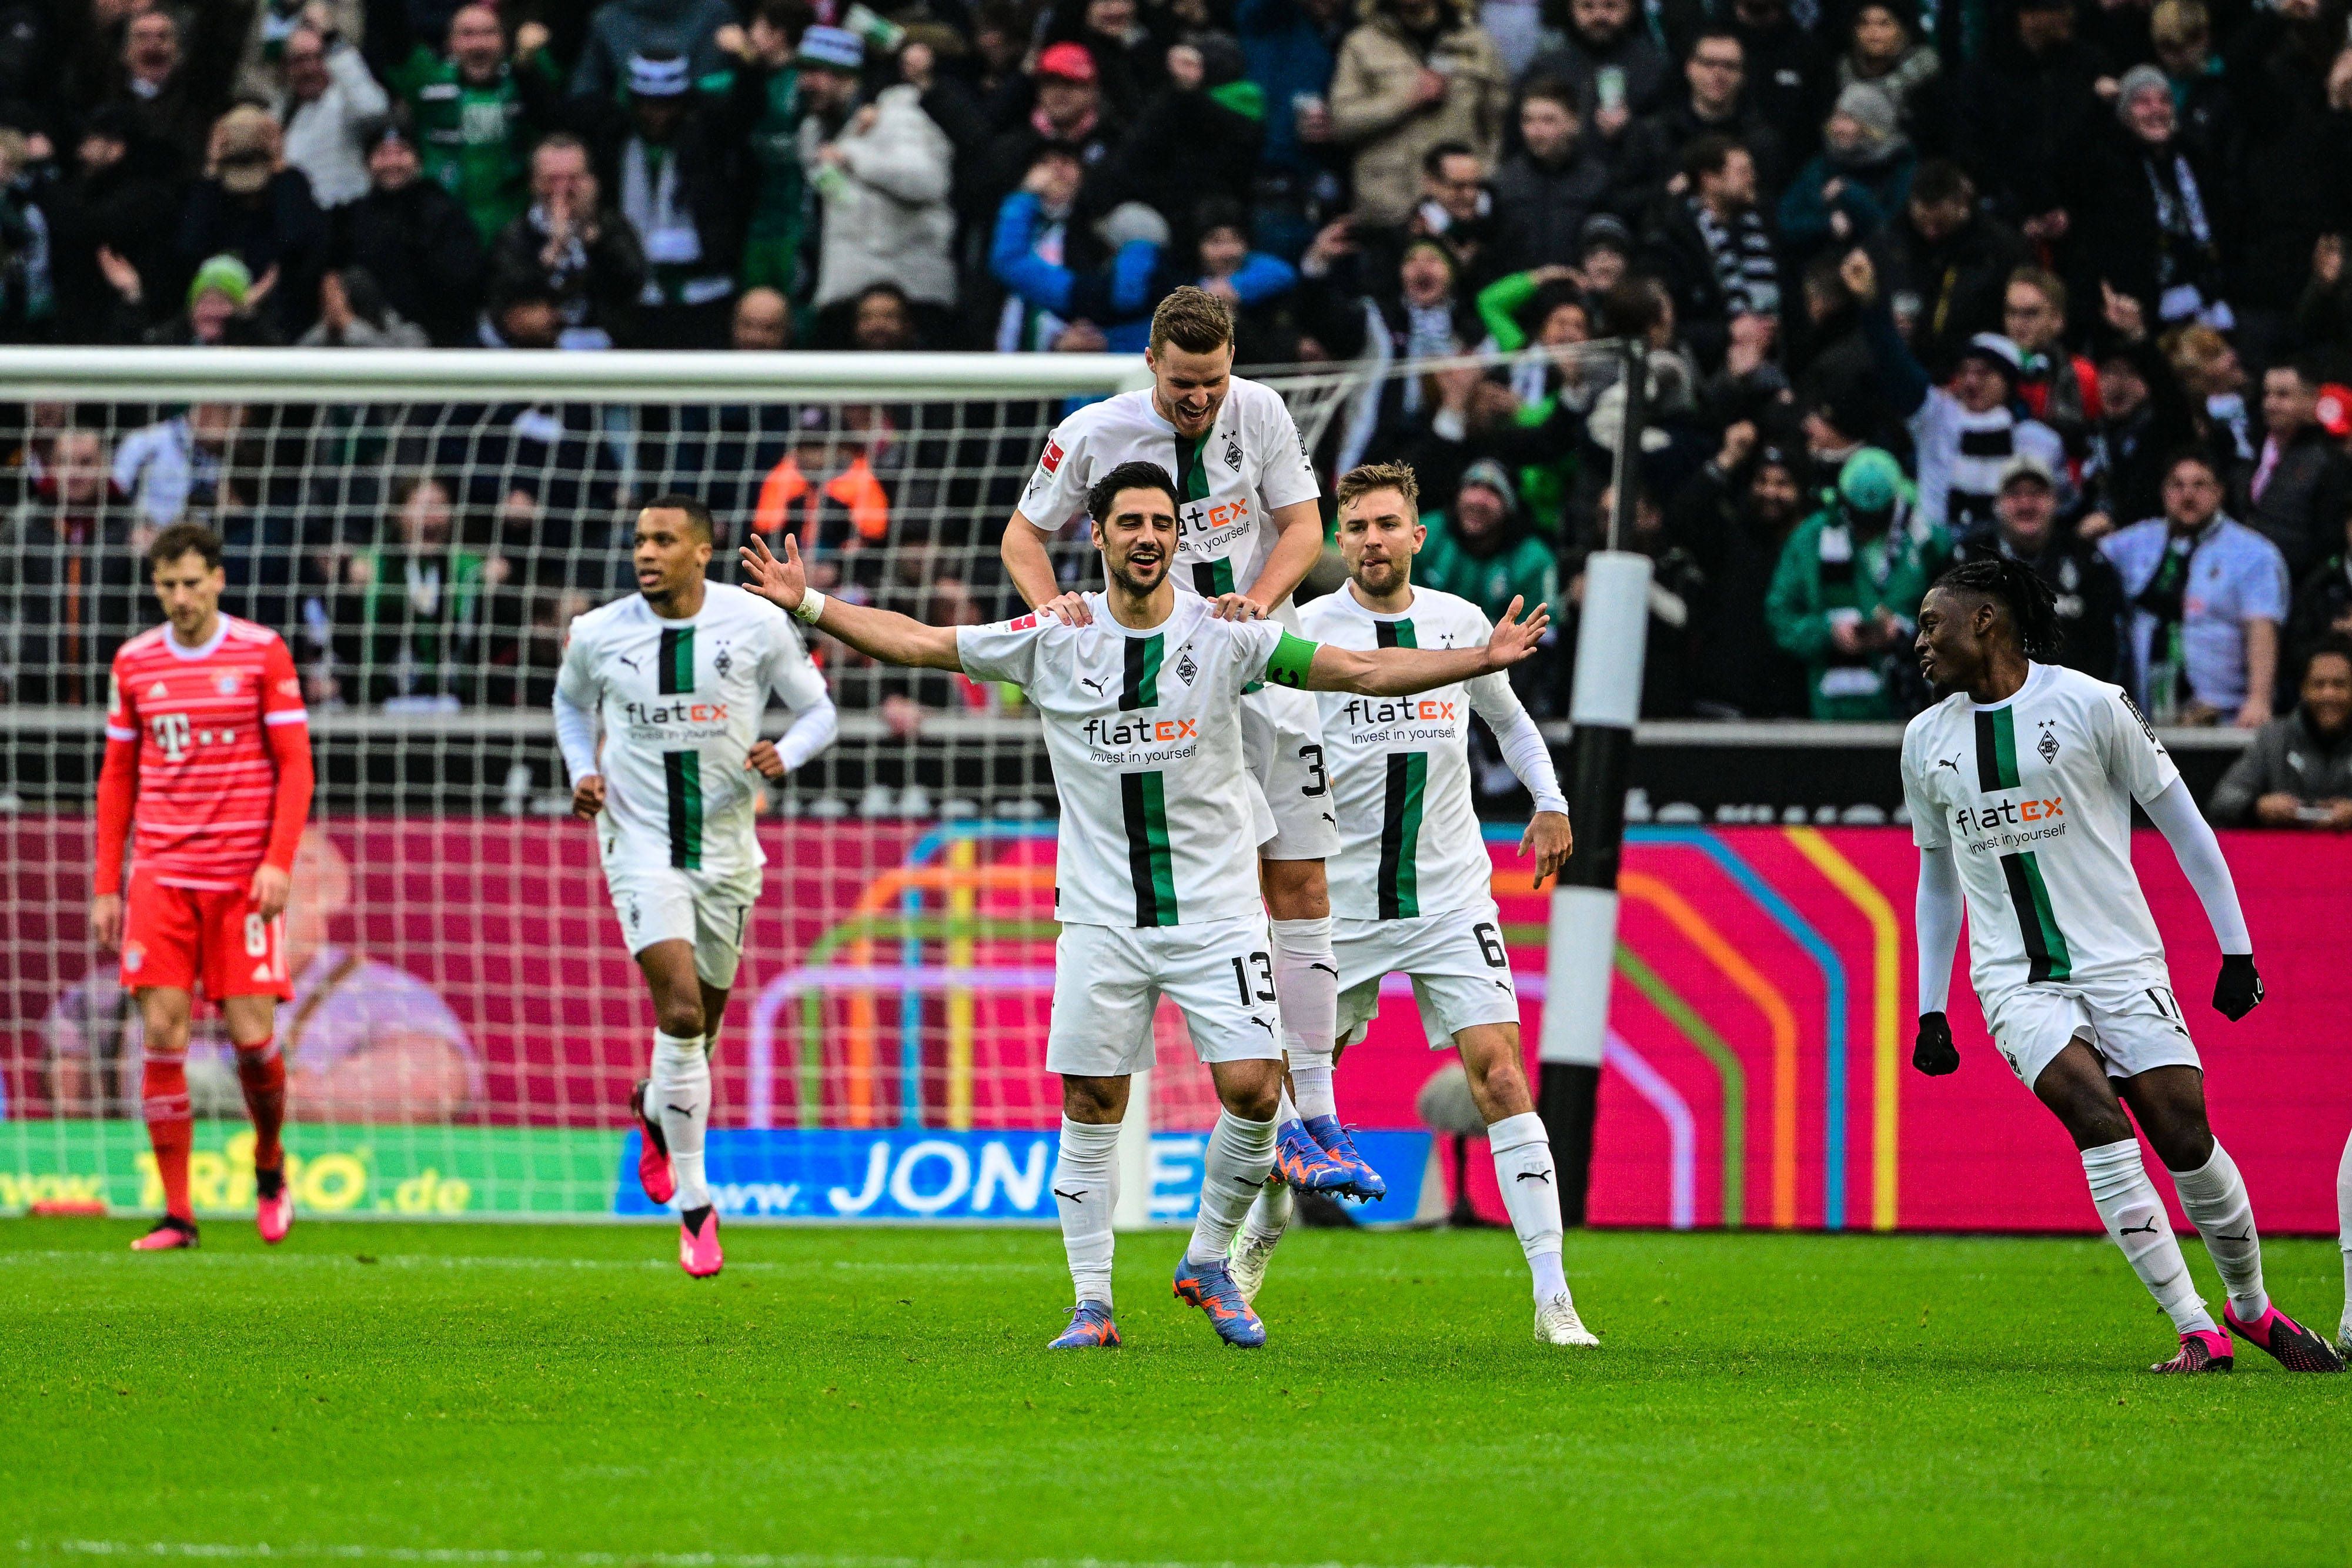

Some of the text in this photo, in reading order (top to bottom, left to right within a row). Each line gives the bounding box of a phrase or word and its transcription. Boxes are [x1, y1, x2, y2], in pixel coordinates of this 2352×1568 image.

[1204, 521, 1250, 553] yourself
[1271, 667, 1299, 688] C
[1351, 727, 1456, 744] Invest in yourself
[1090, 744, 1197, 765] Invest in yourself
[1969, 823, 2067, 854] Invst in yourself
[245, 912, 267, 957] 8
[1472, 922, 1508, 969] 6
[1232, 952, 1277, 1008] 13
